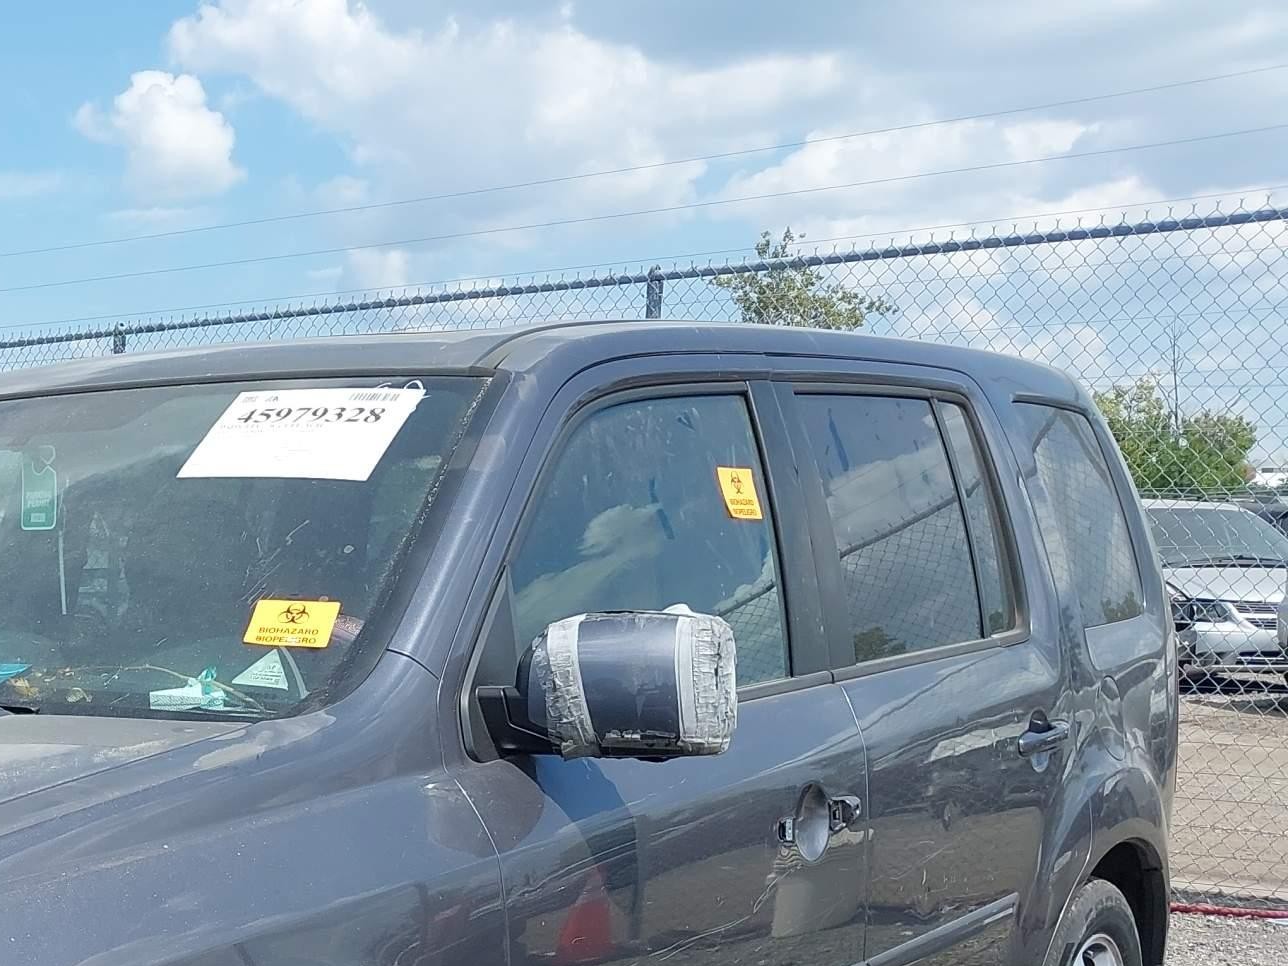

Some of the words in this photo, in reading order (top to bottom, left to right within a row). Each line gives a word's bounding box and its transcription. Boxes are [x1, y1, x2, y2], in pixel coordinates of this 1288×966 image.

[238, 407, 386, 424] 45979328
[258, 626, 319, 635] BIOHAZARD
[255, 635, 317, 644] BIOPEGRO
